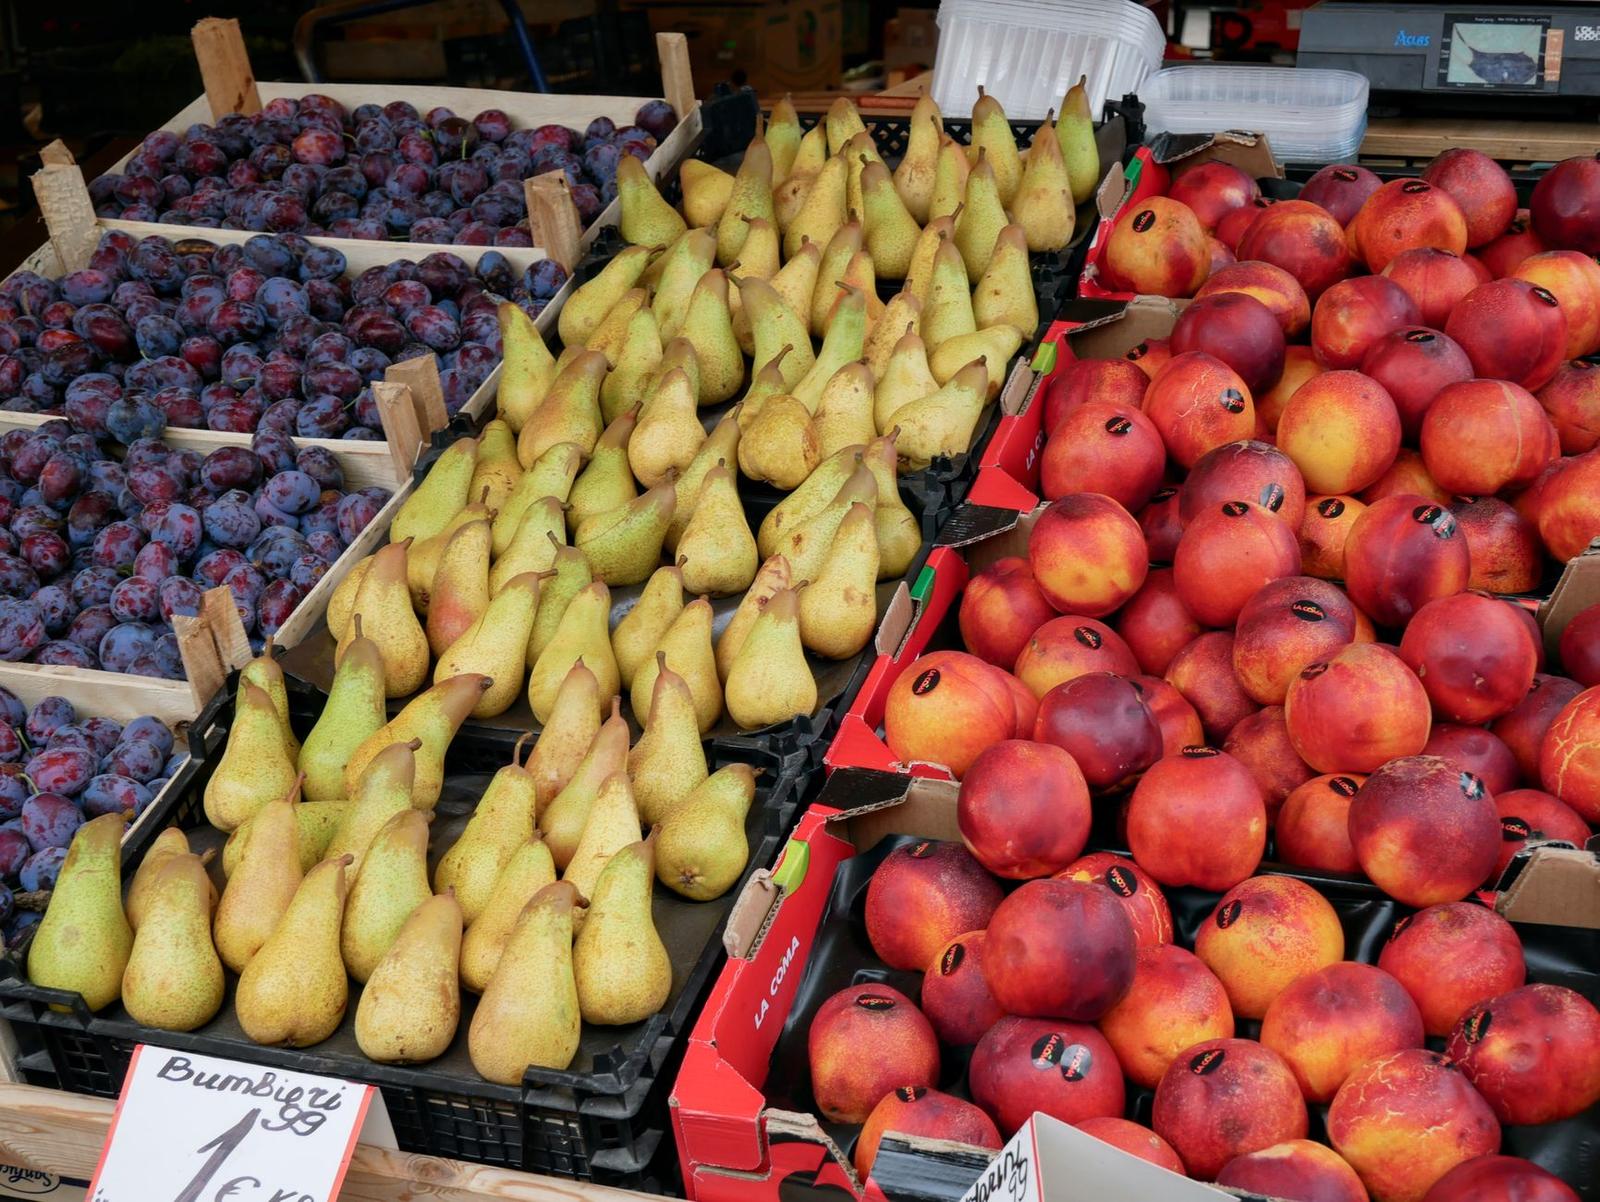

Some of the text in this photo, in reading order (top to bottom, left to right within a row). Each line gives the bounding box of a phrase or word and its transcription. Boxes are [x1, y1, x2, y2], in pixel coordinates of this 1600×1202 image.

[1026, 448, 1035, 470] LA
[1304, 606, 1324, 618] COMA
[1112, 868, 1132, 896] LA COMA
[754, 936, 800, 1030] LA COMA
[1036, 1034, 1059, 1064] LA COMA
[1202, 1050, 1221, 1068] COMA
[173, 1104, 327, 1202] 1 99
